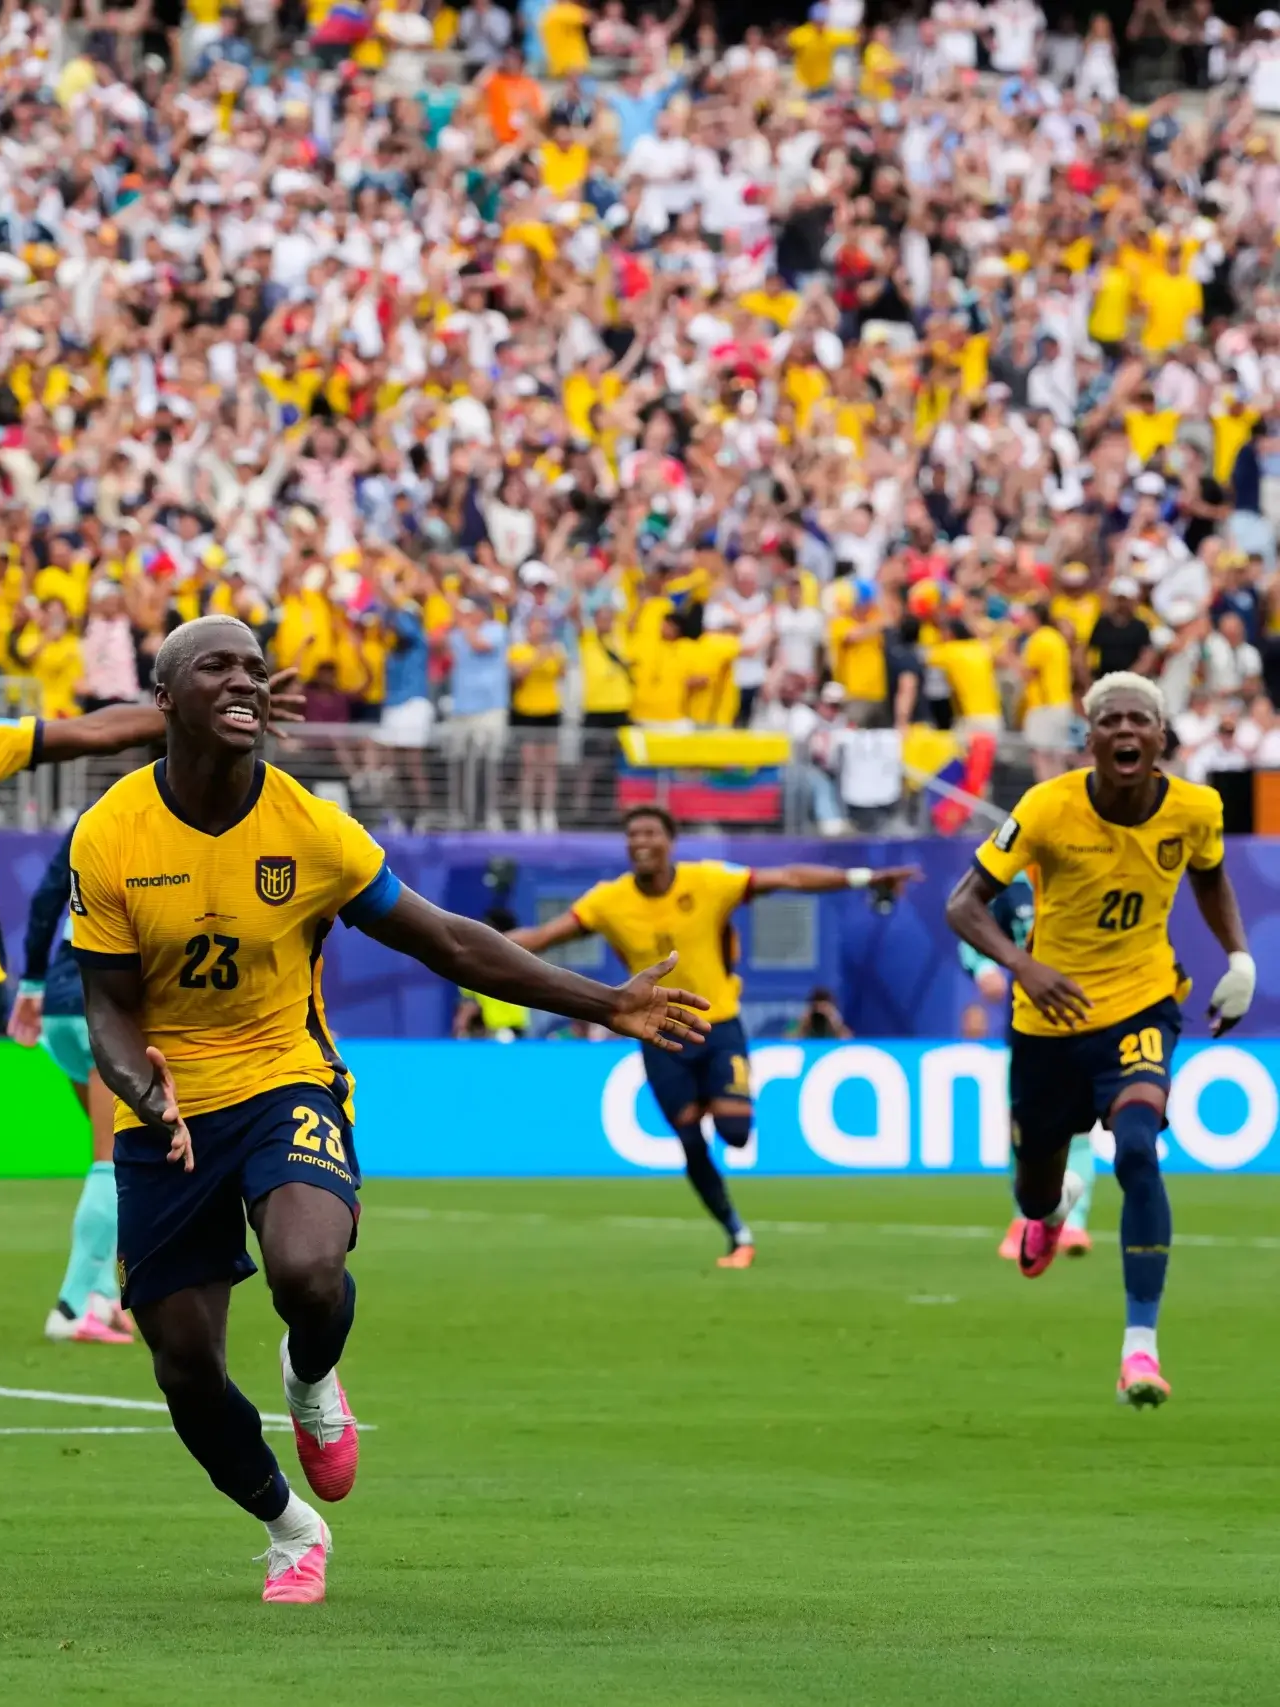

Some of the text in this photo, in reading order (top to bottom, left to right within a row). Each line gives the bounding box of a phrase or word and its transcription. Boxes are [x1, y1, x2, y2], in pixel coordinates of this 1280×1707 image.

[125, 873, 190, 888] marathon
[1097, 889, 1144, 931] 20
[179, 933, 240, 991] 23
[1119, 1027, 1163, 1066] 20
[292, 1105, 345, 1163] 23
[287, 1152, 352, 1185] marathon
